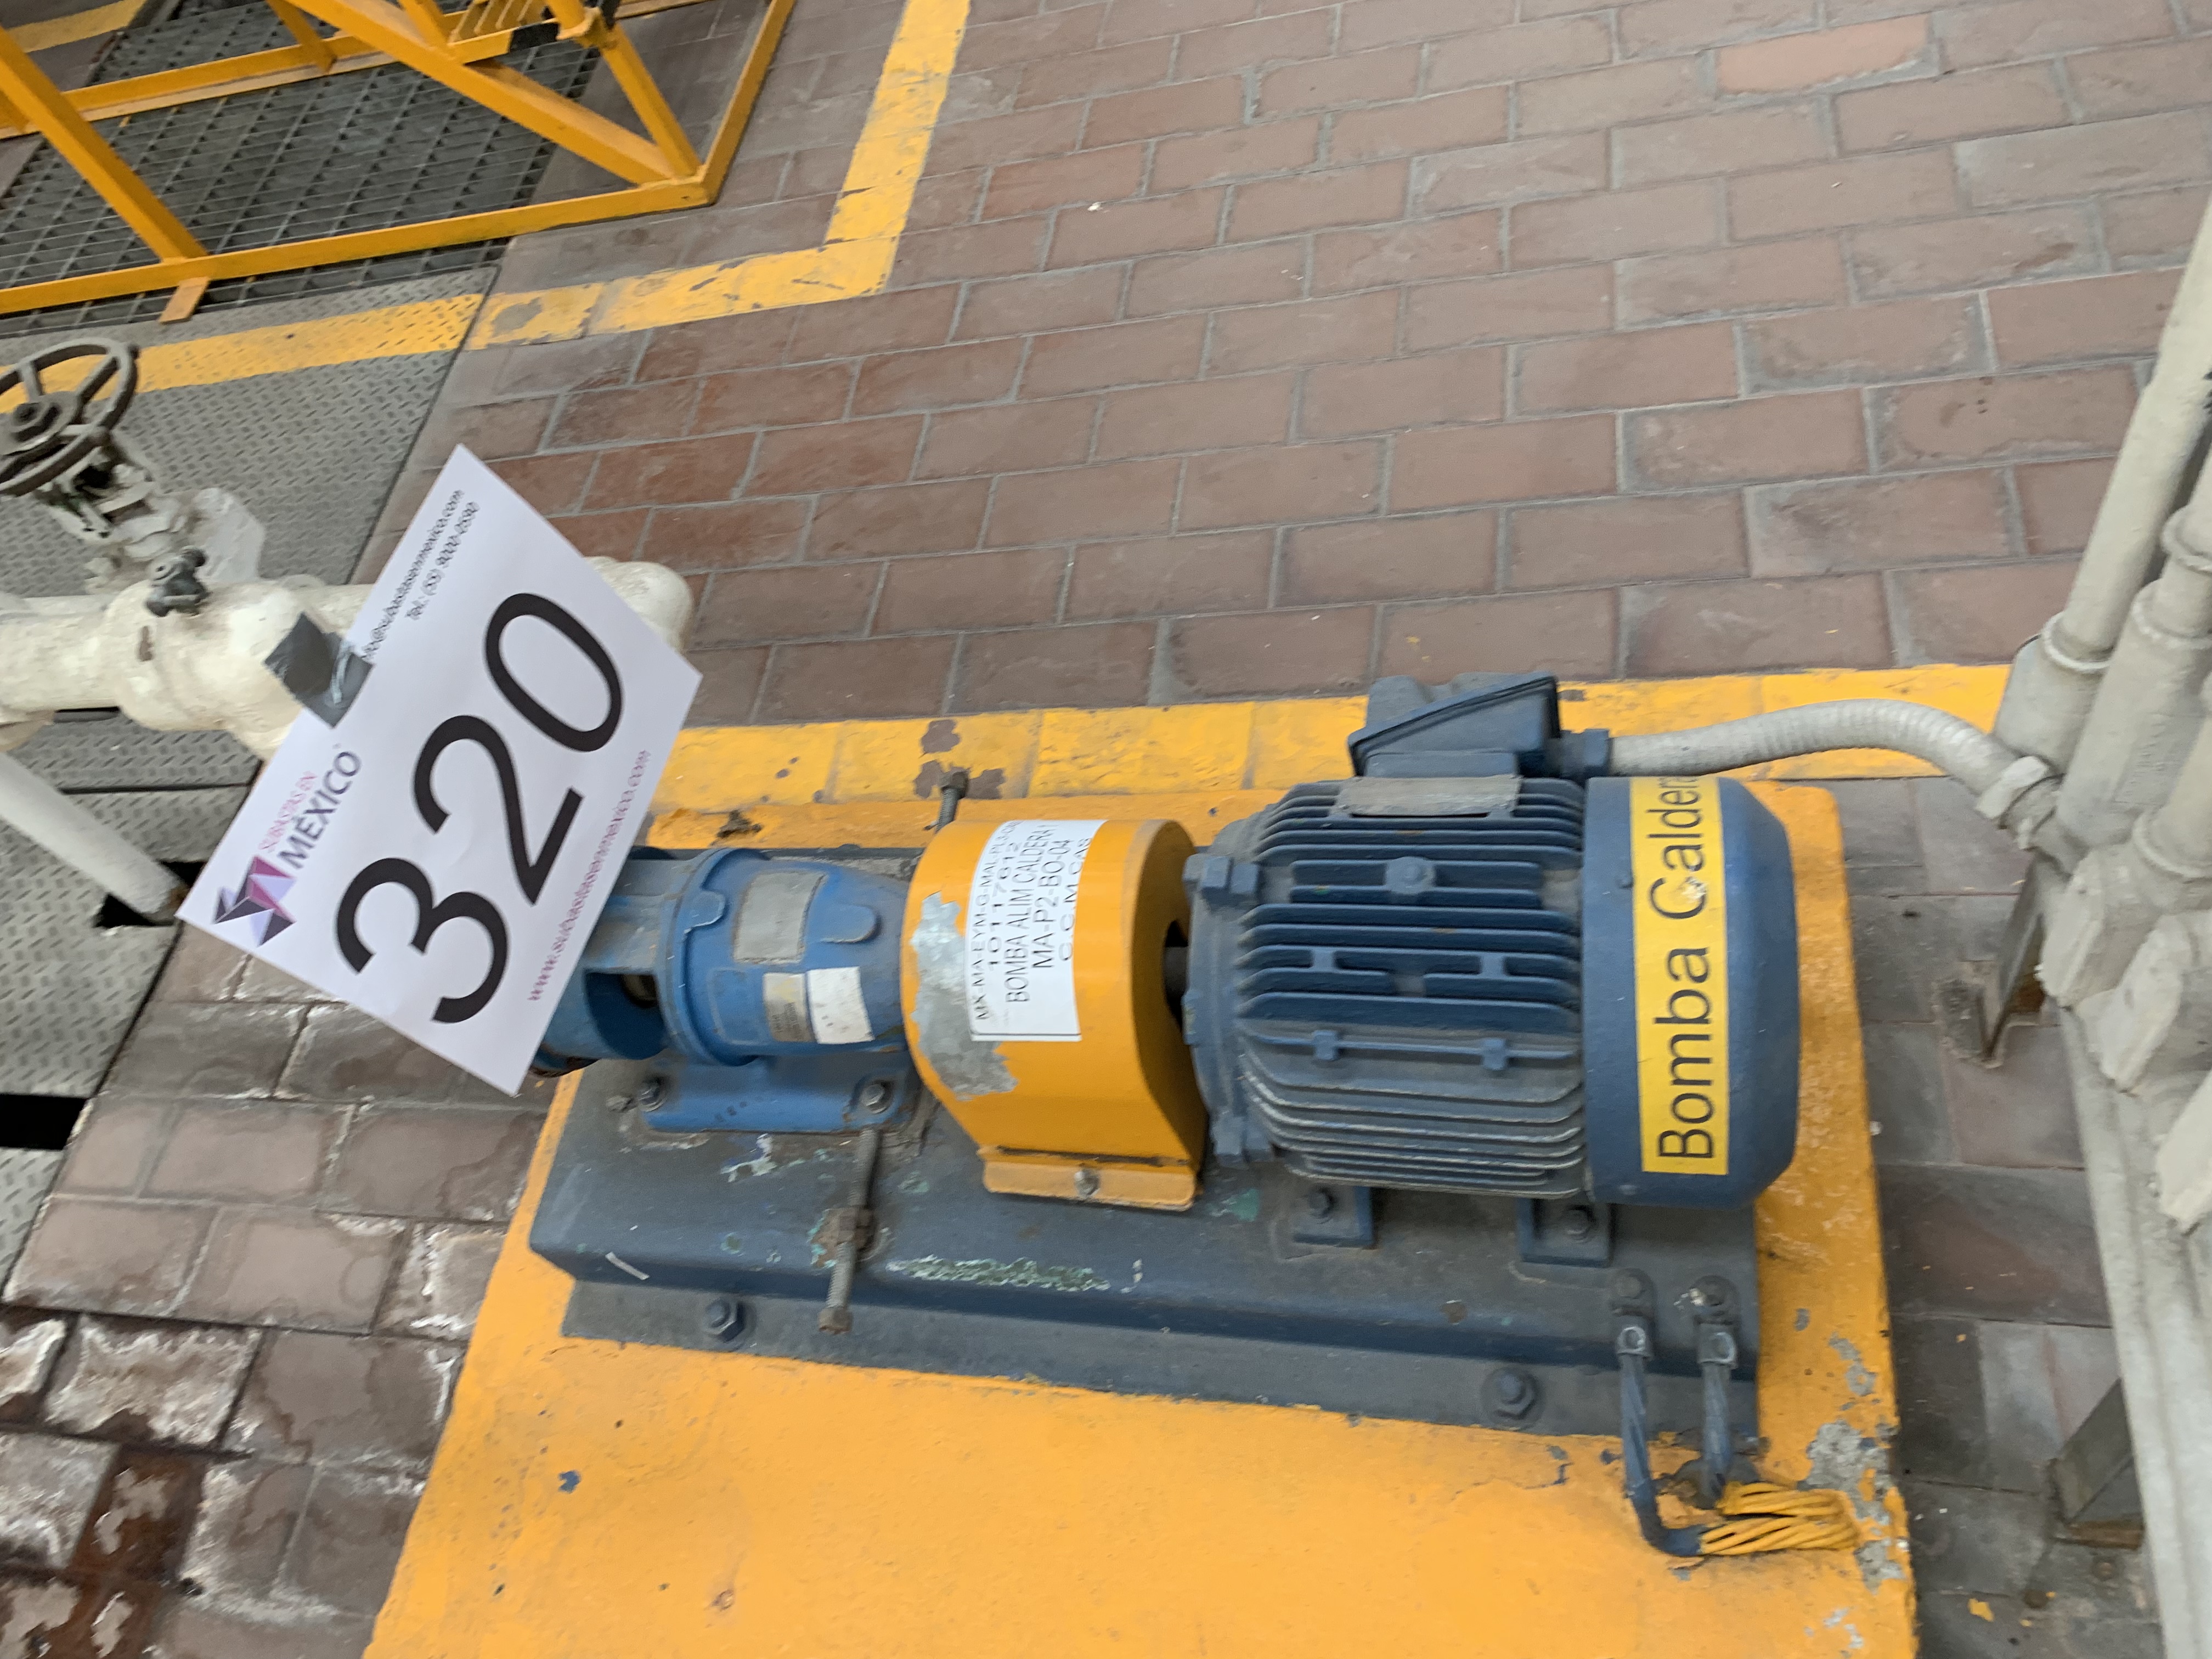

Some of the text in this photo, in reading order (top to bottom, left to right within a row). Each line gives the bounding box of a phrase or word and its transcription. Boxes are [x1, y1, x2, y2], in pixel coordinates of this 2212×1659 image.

[278, 751, 362, 869] MÉXICO
[295, 771, 318, 792] EN
[336, 592, 623, 1024] 320
[527, 750, 651, 1001] www.subastasenmexico.com
[1012, 828, 1057, 884] CALDERA
[1006, 888, 1035, 930] ALIM
[1003, 934, 1030, 1003] BOMBA
[1652, 946, 1714, 1158] Bomba
